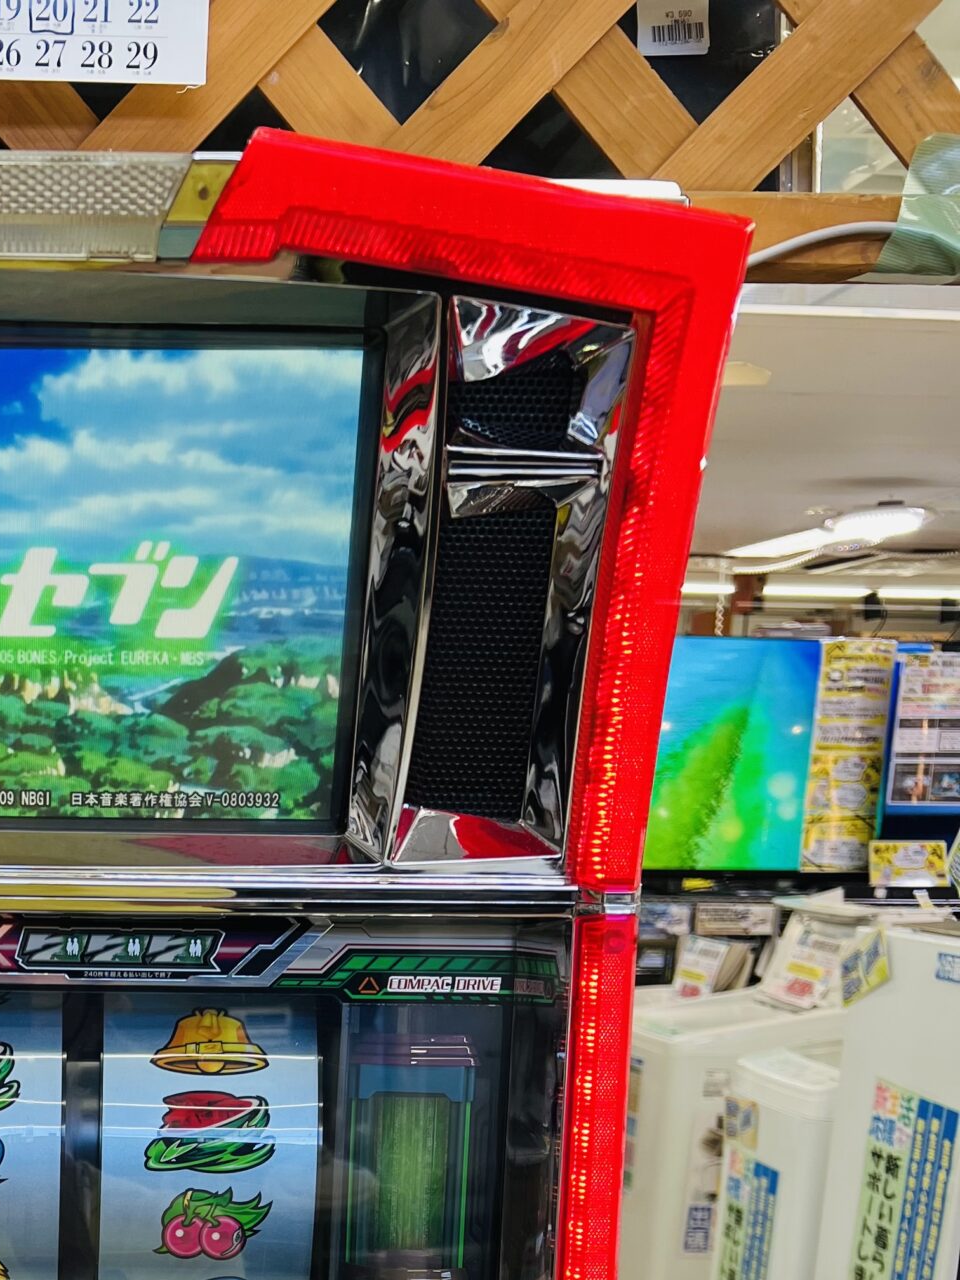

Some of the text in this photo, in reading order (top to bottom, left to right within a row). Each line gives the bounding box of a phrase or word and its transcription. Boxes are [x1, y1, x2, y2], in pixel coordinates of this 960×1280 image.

[35, 39, 67, 68] 27
[81, 40, 113, 69] 28
[126, 41, 159, 70] 29
[21, 790, 51, 806] NBGI
[388, 976, 452, 993] COMPAC
[455, 976, 502, 993] DRIVE
